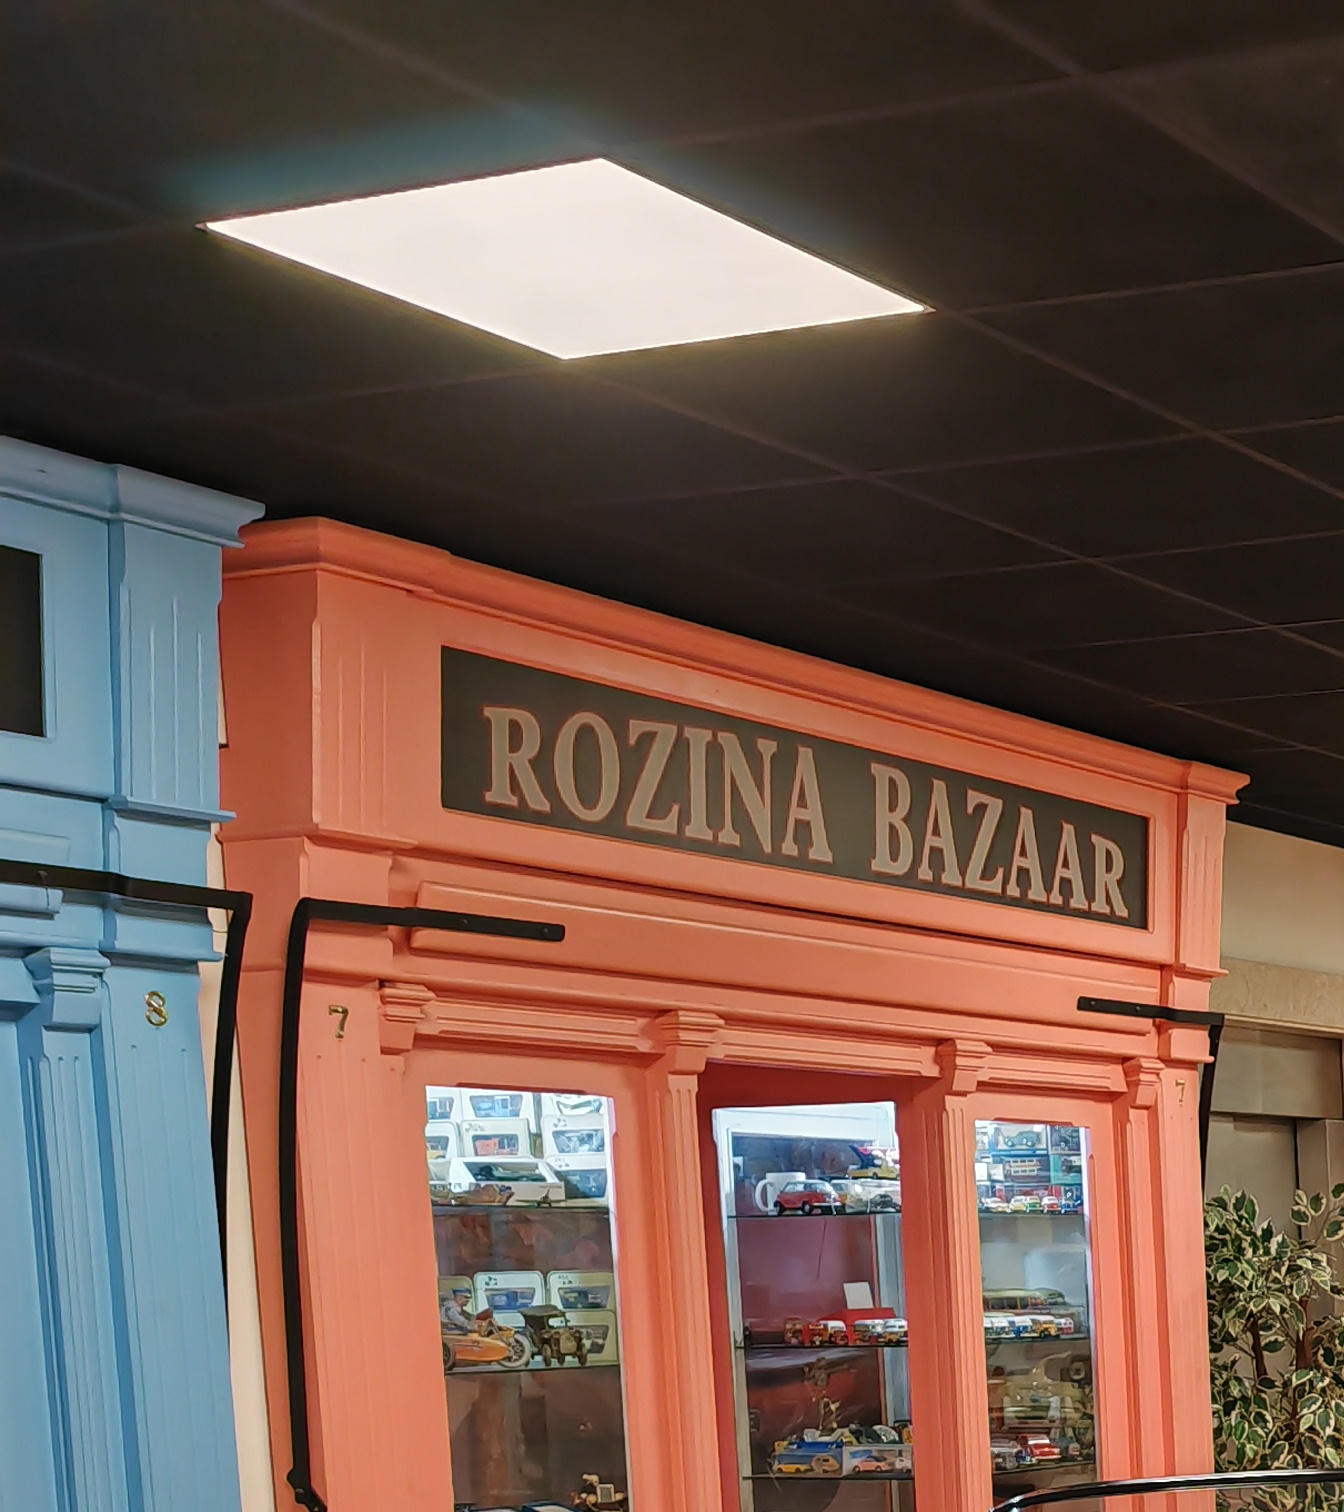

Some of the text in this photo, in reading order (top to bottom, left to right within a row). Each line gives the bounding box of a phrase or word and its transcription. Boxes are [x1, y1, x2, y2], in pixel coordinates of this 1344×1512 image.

[482, 705, 1129, 918] ROZINA BAZAAR
[145, 990, 168, 1027] 8
[328, 1004, 349, 1039] 7
